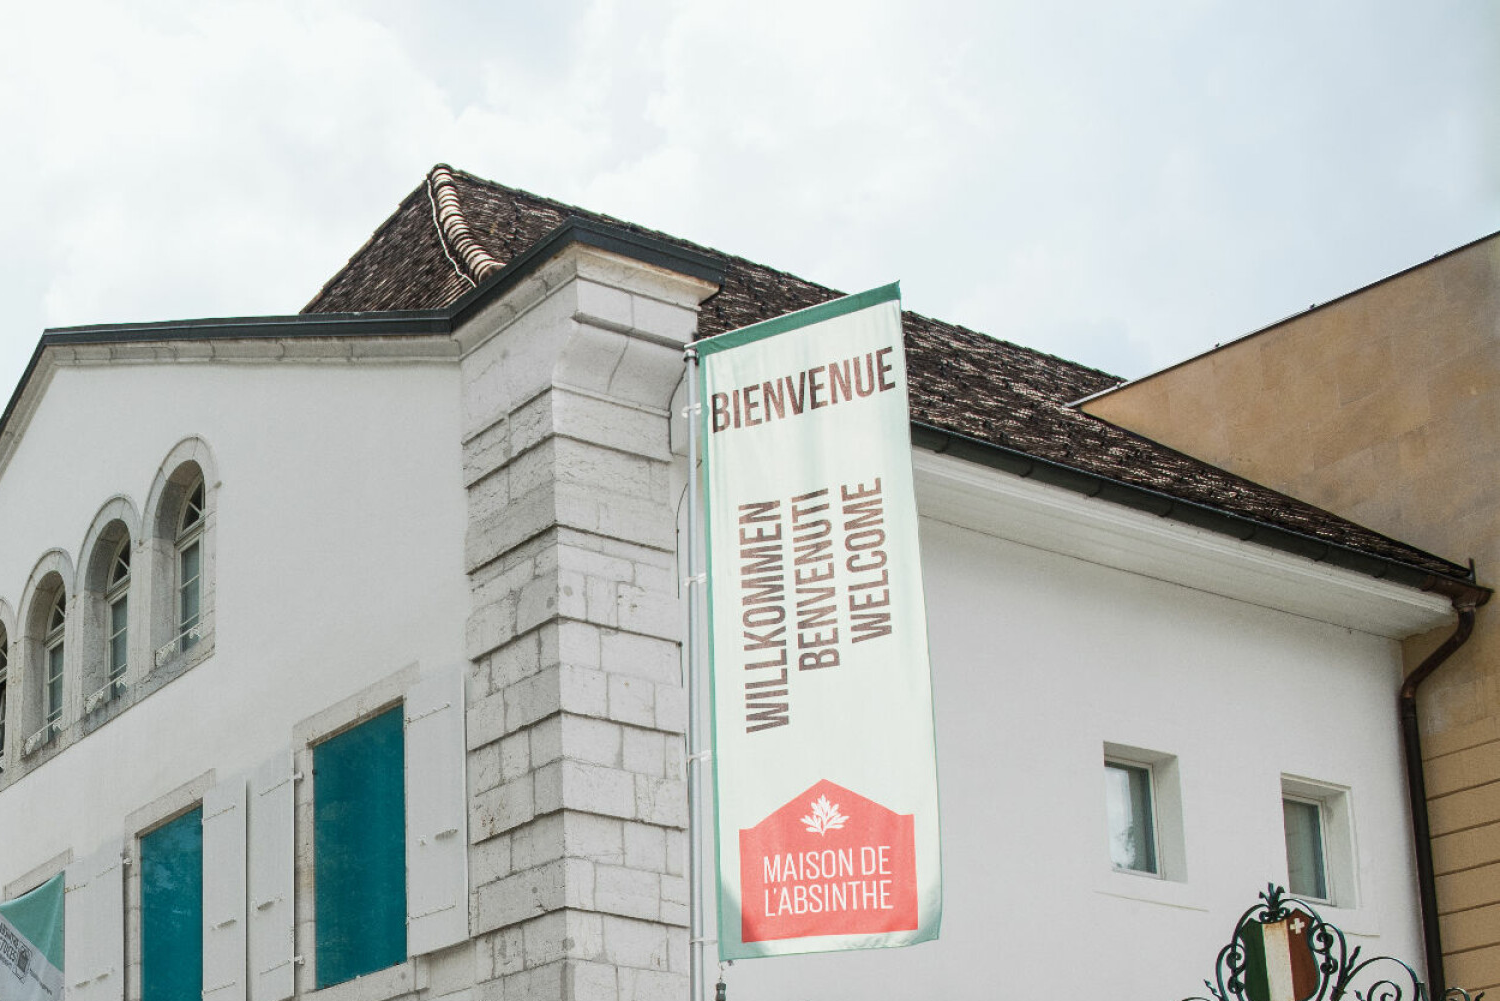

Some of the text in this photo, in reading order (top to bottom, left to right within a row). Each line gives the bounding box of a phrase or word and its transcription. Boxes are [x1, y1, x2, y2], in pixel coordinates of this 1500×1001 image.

[711, 347, 895, 433] BIENVENUE
[738, 500, 790, 734] WILLKOMMEN
[791, 487, 841, 671] BENVENUTI
[841, 477, 892, 643] WELCOME
[763, 845, 892, 884] MAISON DE
[764, 880, 894, 917] L'ABSINTHE
